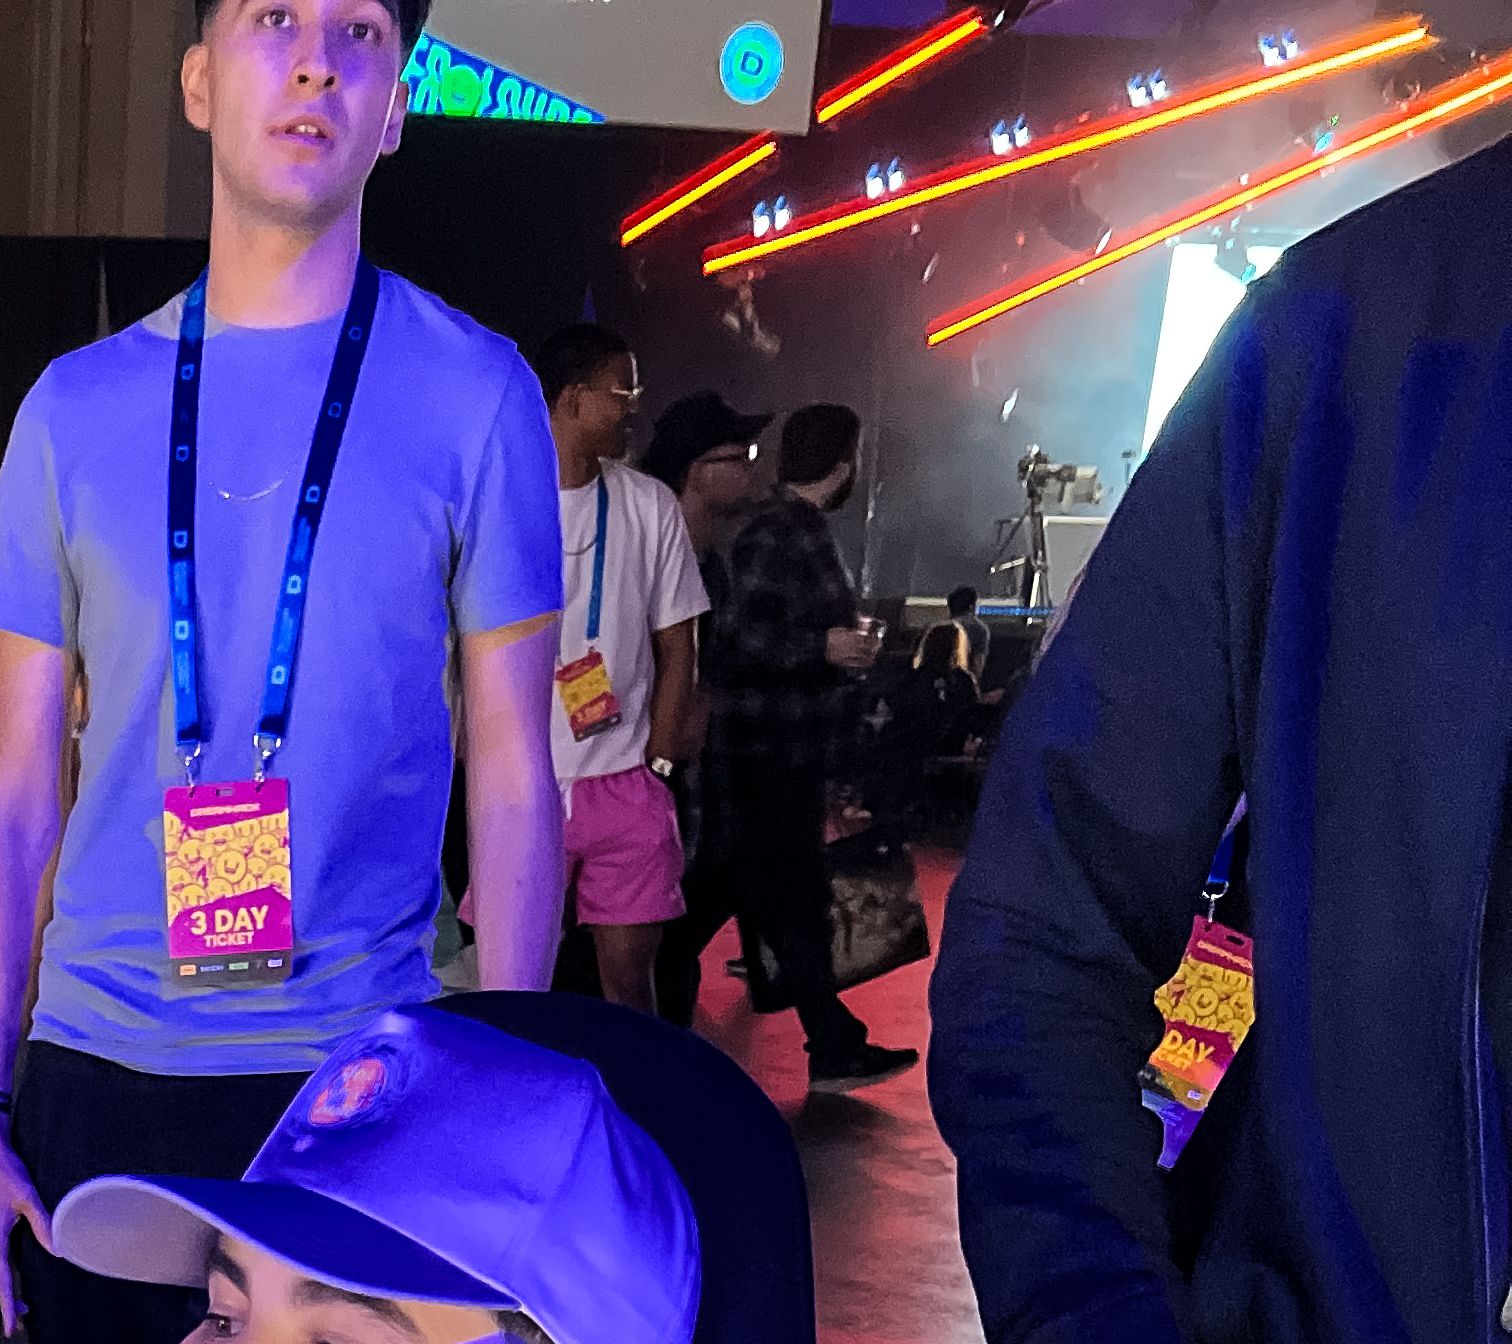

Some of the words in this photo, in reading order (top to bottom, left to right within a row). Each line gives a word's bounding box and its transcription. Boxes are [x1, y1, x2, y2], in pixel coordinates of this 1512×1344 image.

[189, 910, 208, 936] 3
[214, 904, 269, 934] DAY
[203, 930, 255, 948] TICKET
[1162, 1029, 1216, 1063] DAY
